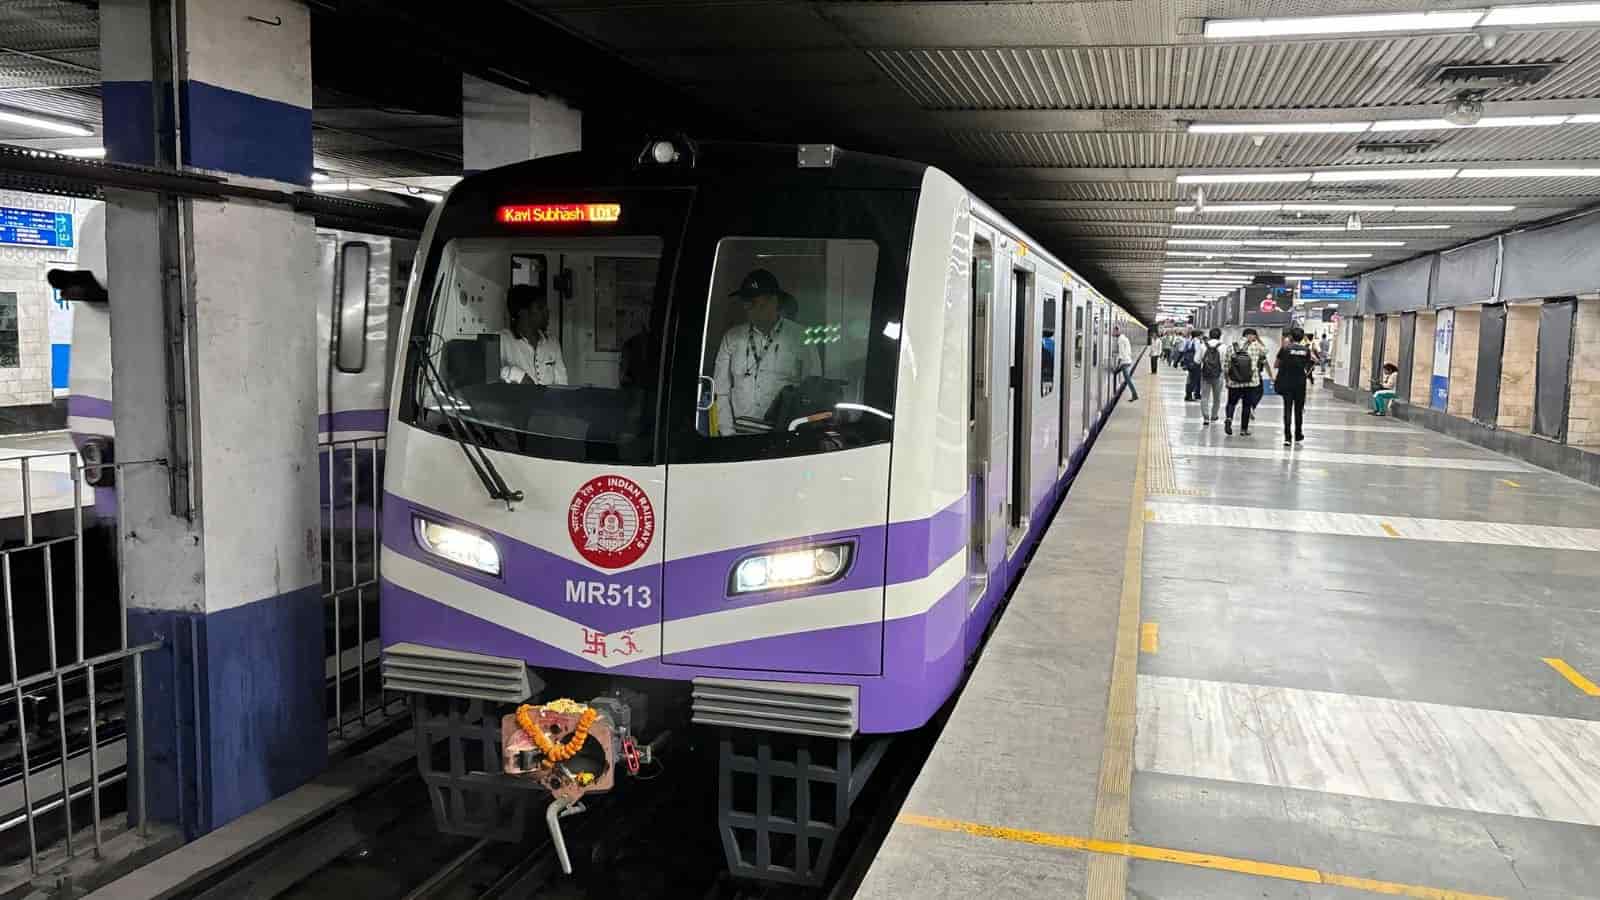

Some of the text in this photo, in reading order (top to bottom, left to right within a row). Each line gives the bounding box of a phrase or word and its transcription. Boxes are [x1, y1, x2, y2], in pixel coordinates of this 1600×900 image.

[534, 206, 584, 221] Subhash
[607, 478, 653, 549] INDIAN RAILWAYS
[566, 580, 652, 608] MR513
